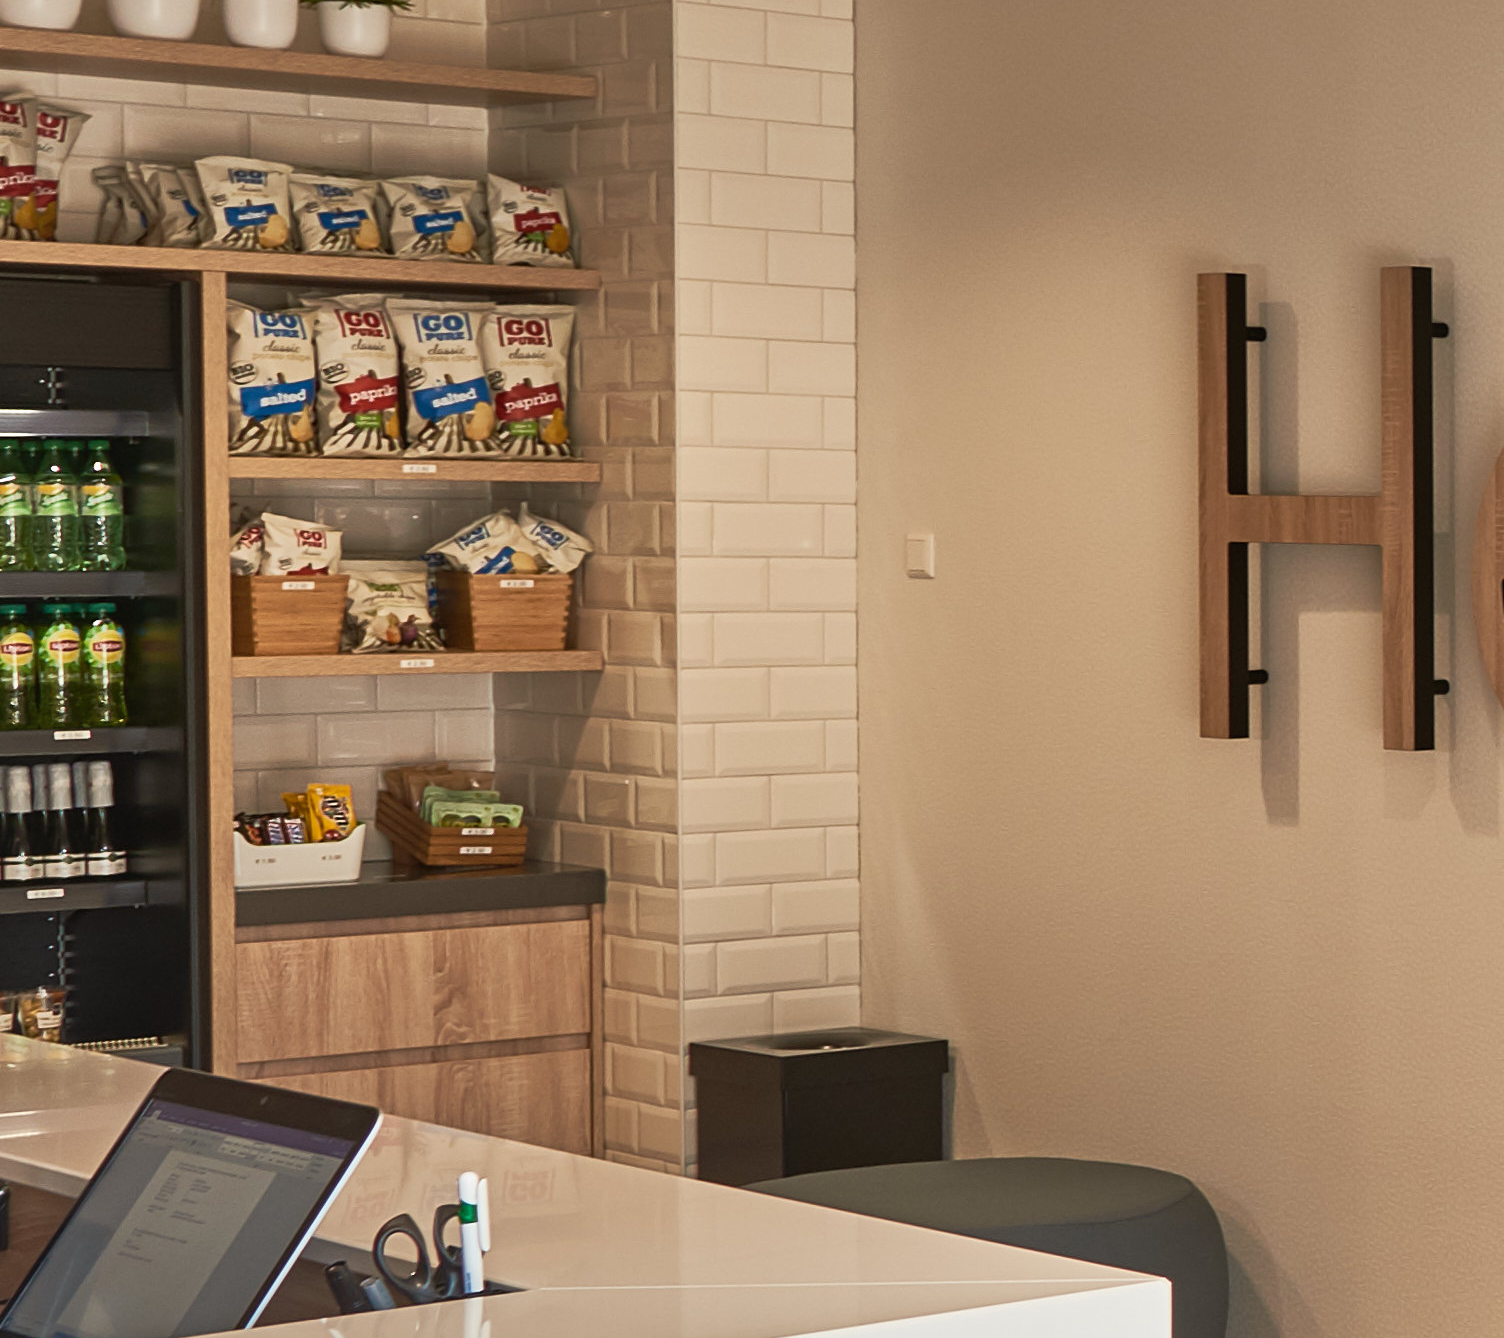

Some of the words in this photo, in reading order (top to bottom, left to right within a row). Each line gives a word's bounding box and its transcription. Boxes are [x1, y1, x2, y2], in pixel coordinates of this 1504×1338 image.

[260, 312, 298, 328] GO
[343, 311, 381, 329] GO
[421, 314, 464, 332] GO
[504, 319, 545, 336] GO
[260, 388, 307, 407] salted
[350, 384, 398, 405] paprik
[432, 387, 478, 408] salted
[505, 392, 559, 413] paprika
